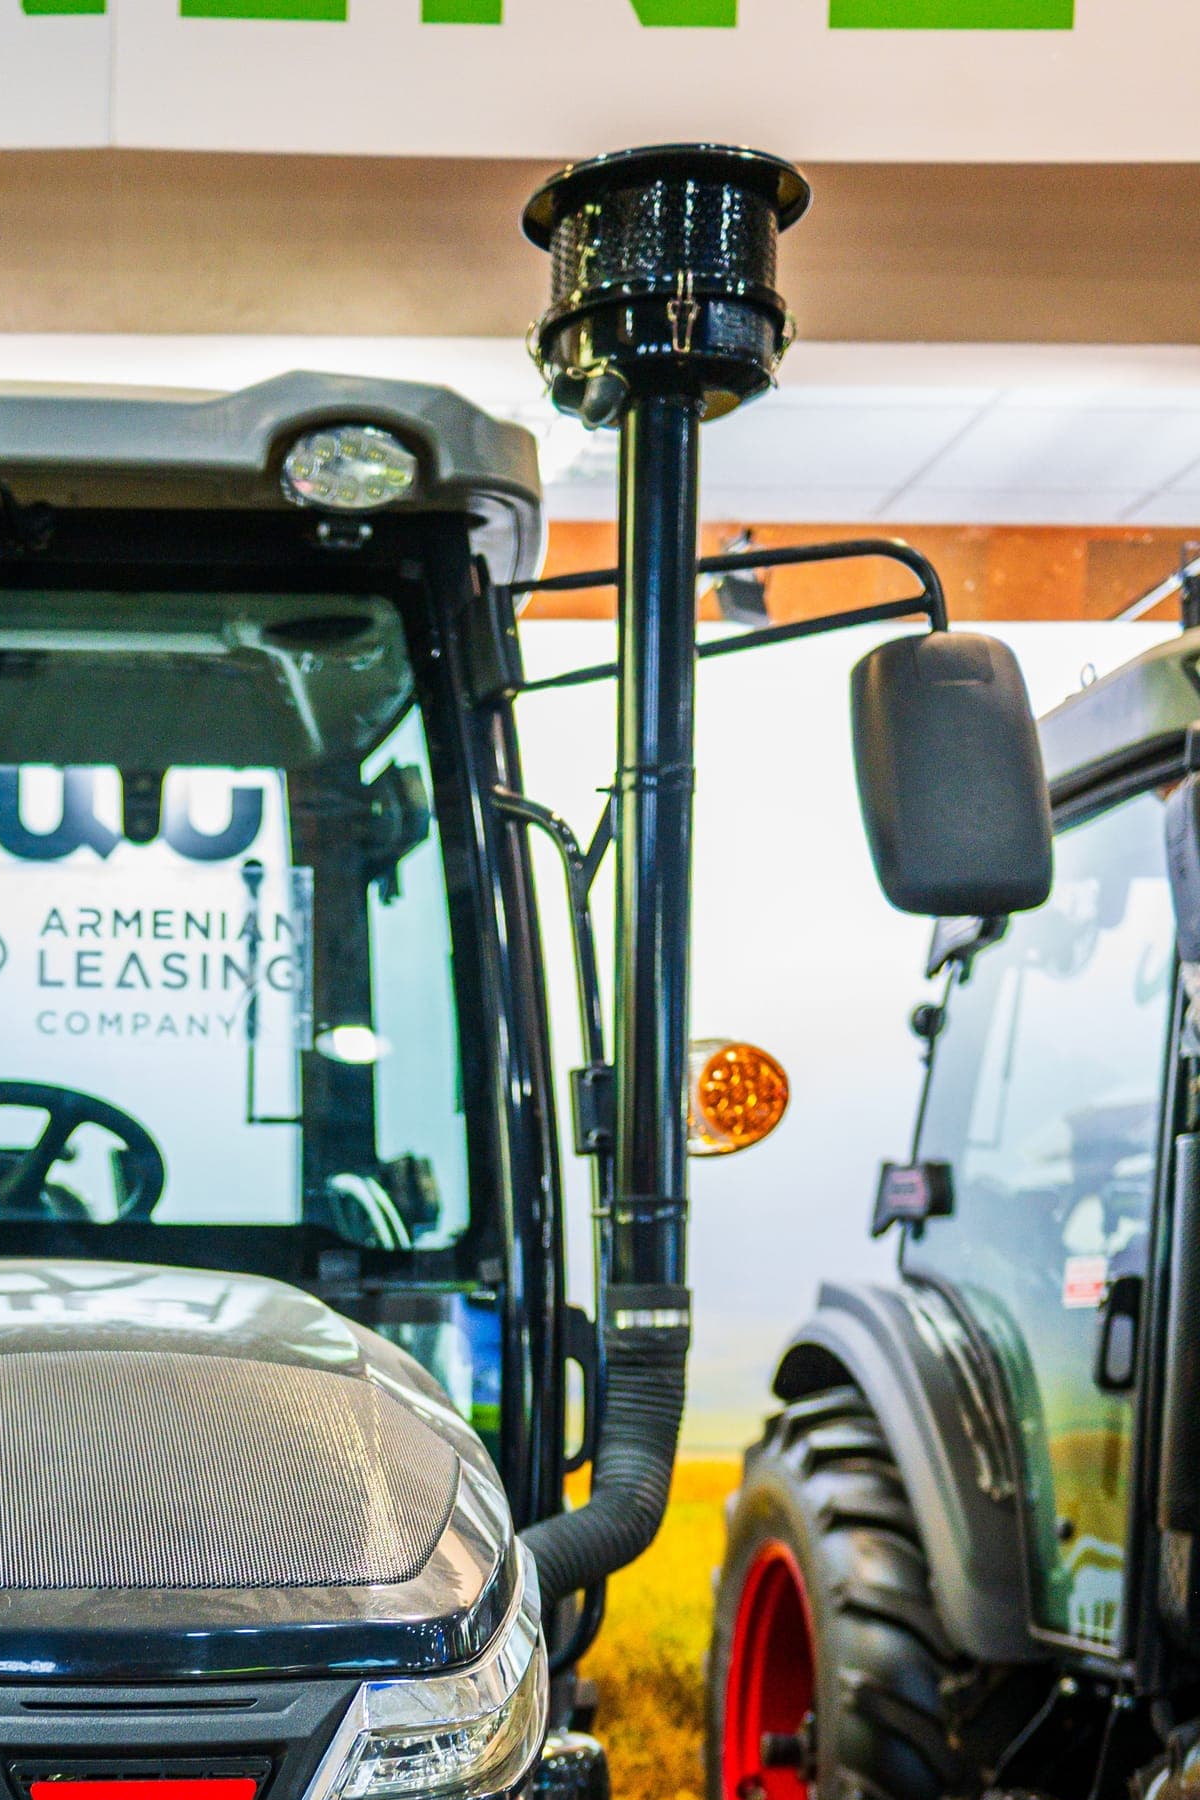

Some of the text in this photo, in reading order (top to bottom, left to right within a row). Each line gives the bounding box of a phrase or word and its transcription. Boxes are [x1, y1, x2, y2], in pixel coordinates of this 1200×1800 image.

[40, 907, 303, 942] ARMENIAN
[37, 951, 305, 992] LEASING
[36, 1010, 237, 1038] COMPANY
